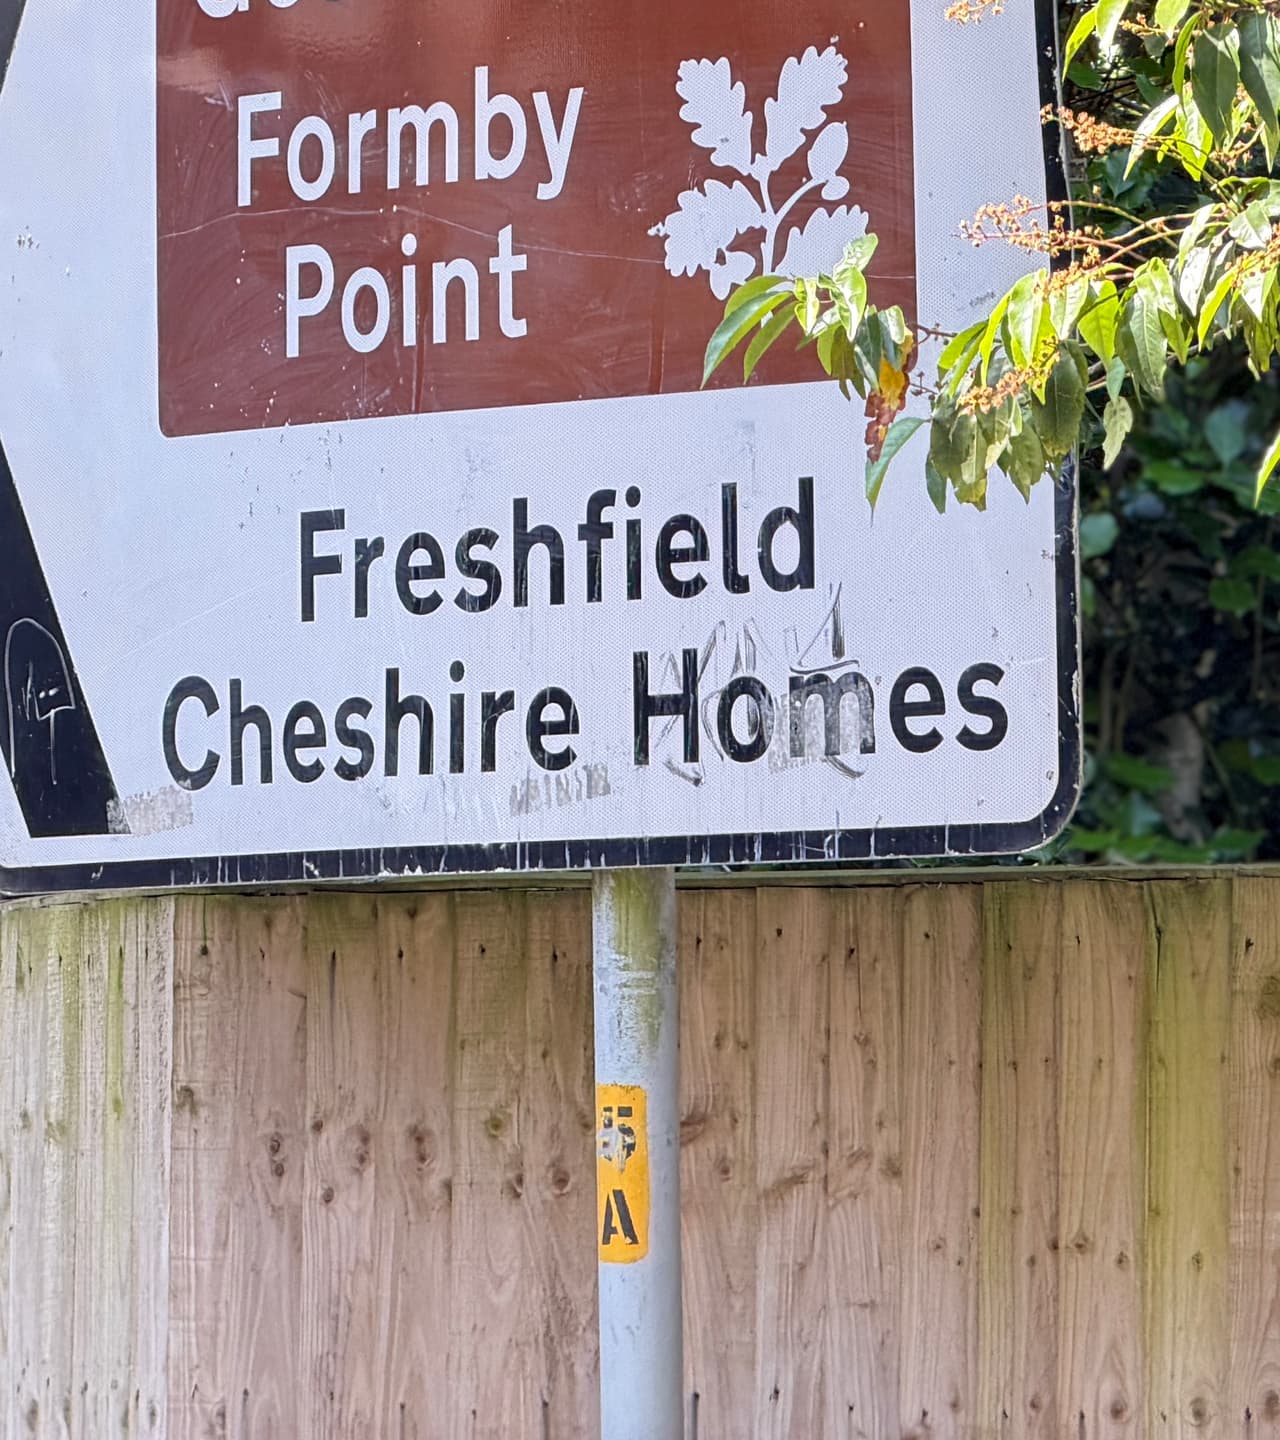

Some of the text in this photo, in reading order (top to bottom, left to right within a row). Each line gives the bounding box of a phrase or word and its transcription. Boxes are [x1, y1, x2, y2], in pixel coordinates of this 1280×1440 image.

[235, 64, 586, 209] Formby
[283, 222, 529, 361] Point
[298, 474, 816, 624] Freshfield
[160, 658, 582, 792] Cheshire
[631, 646, 1010, 768] Homes
